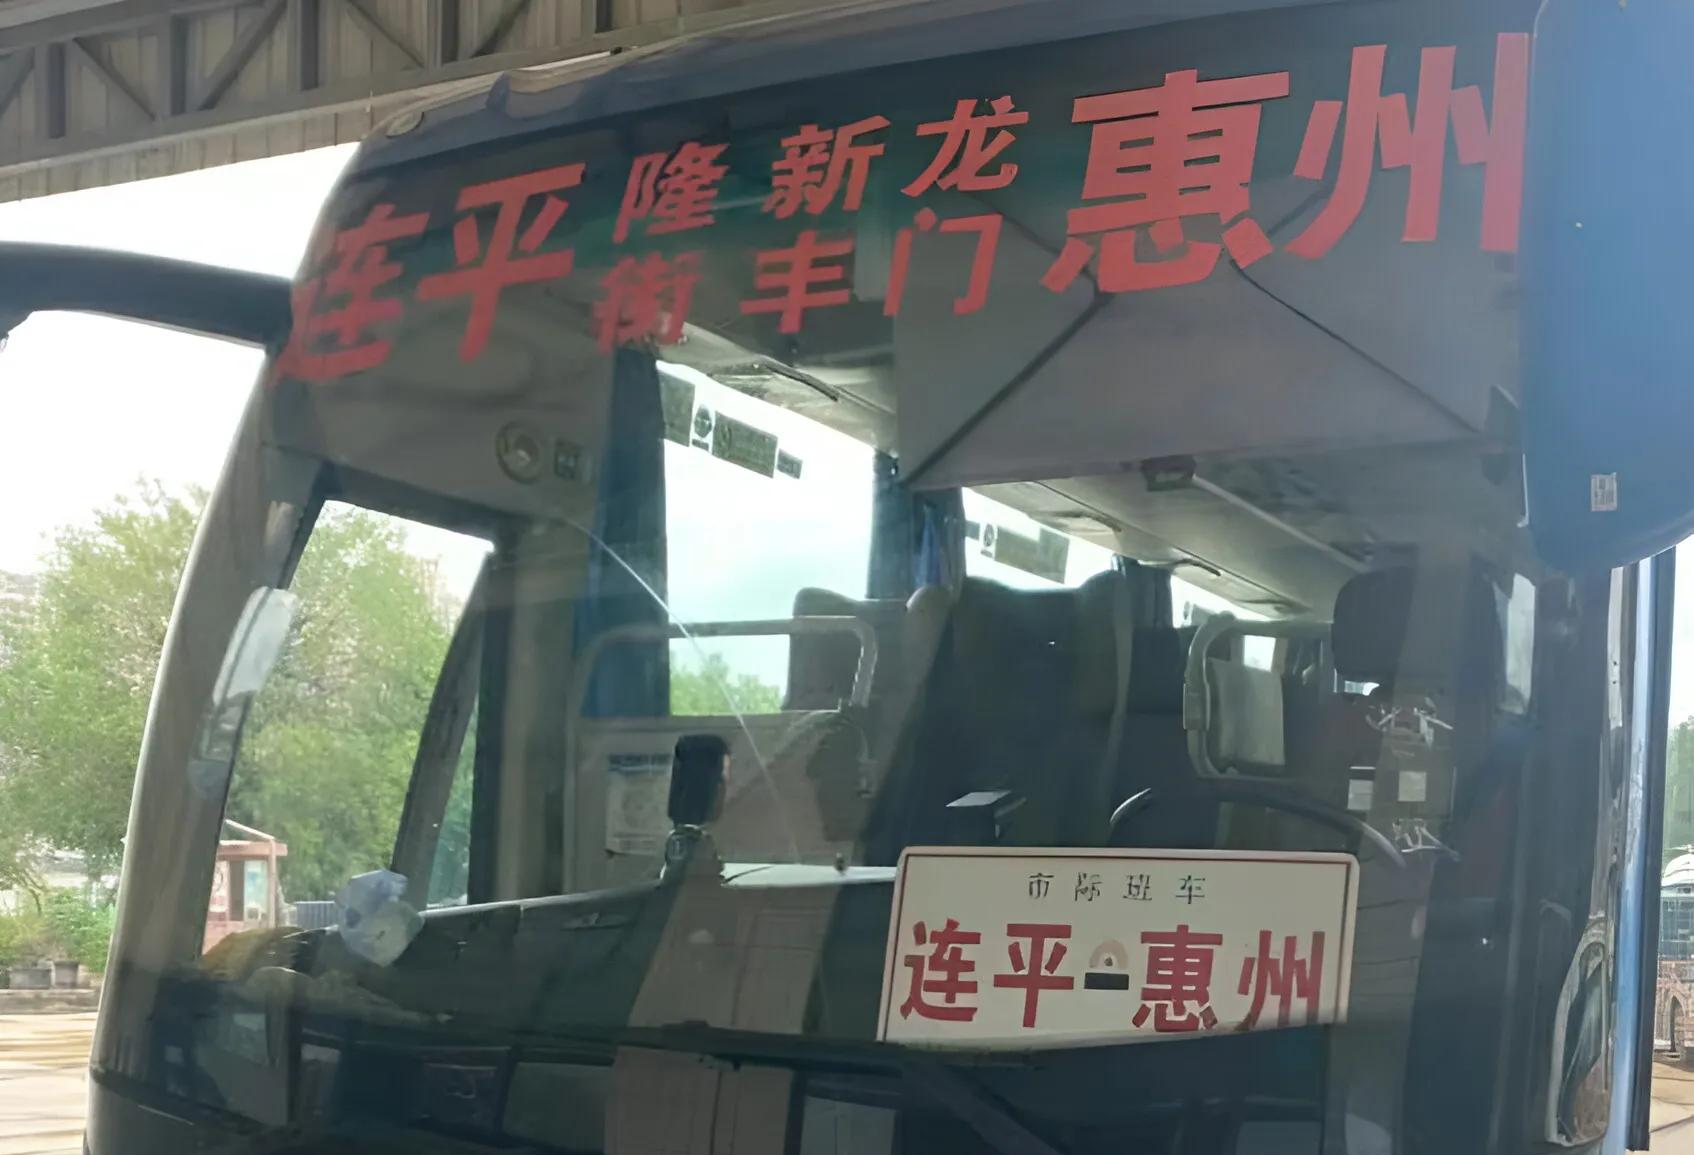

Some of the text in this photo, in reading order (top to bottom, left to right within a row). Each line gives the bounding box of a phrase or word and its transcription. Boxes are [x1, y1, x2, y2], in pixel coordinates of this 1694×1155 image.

[272, 161, 586, 388] 连平
[1041, 33, 1529, 294] 惠州
[1027, 871, 1206, 904] 市际班车
